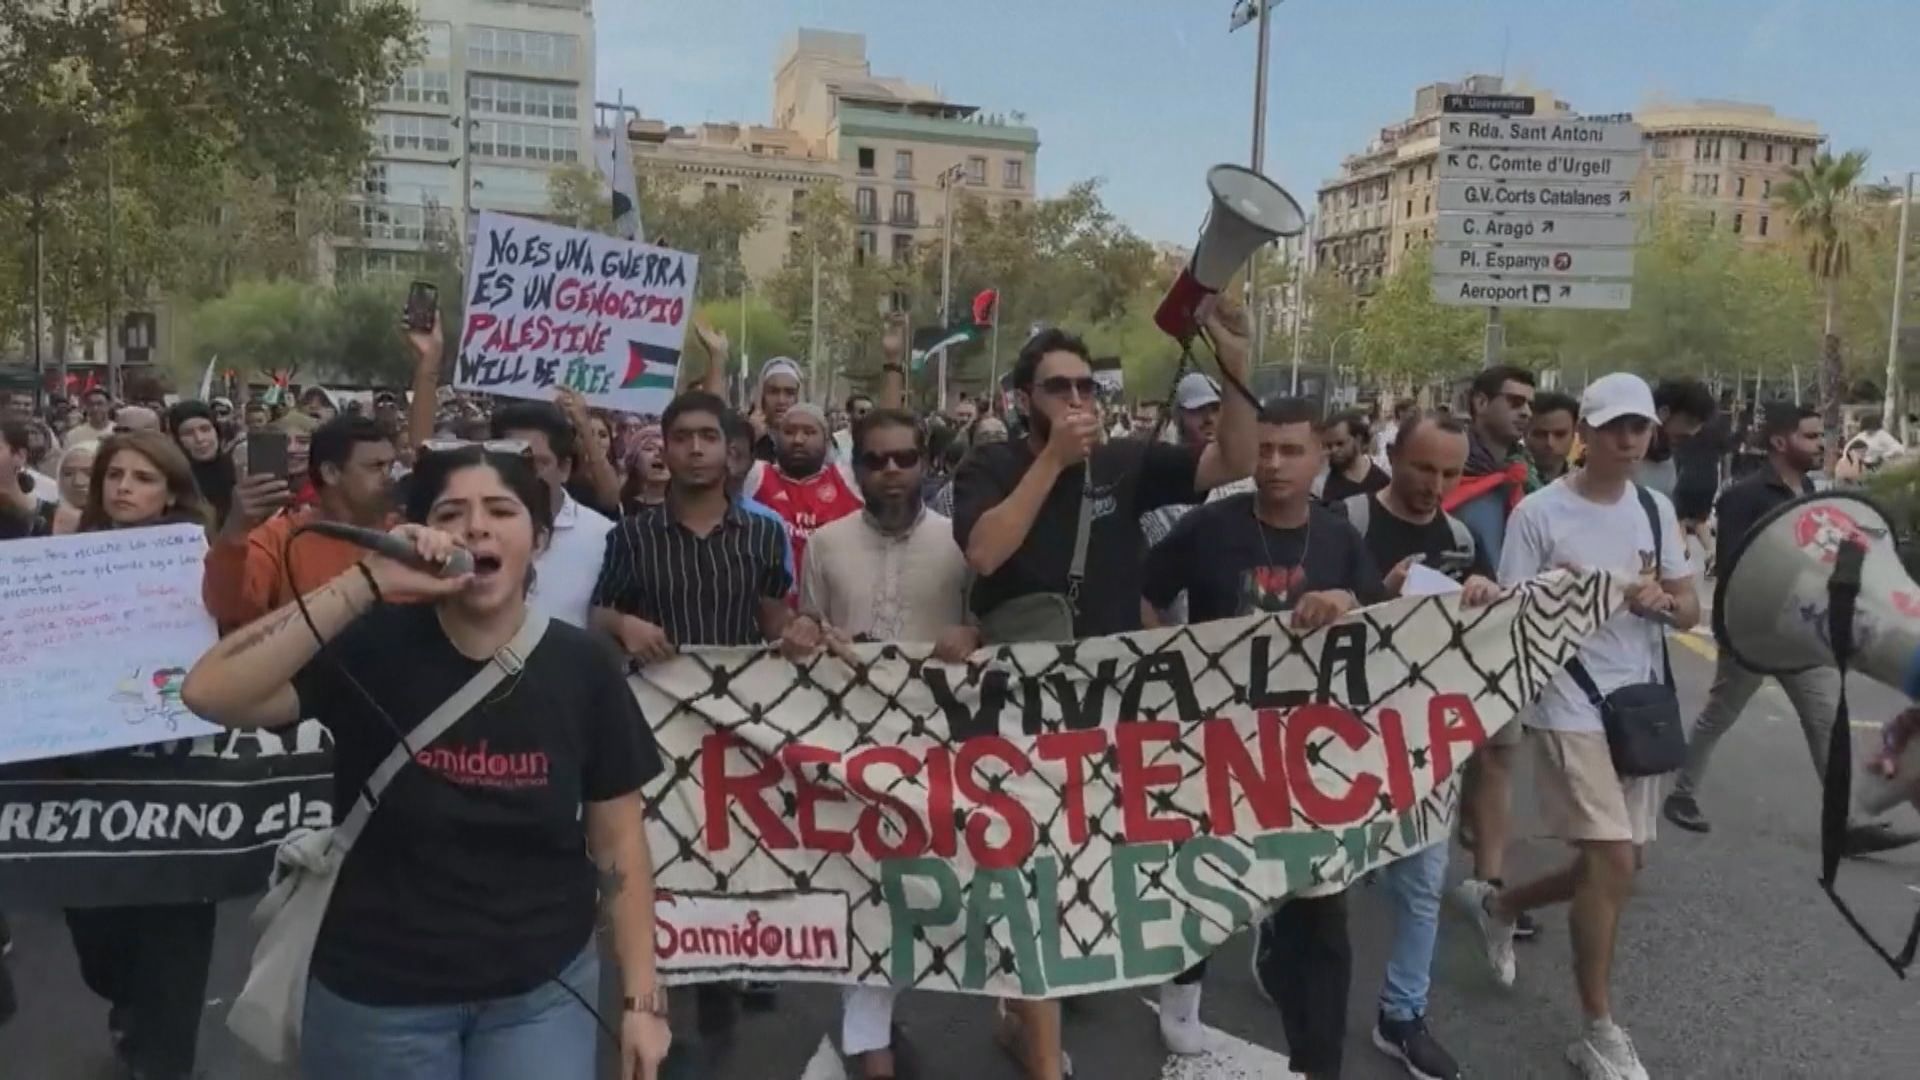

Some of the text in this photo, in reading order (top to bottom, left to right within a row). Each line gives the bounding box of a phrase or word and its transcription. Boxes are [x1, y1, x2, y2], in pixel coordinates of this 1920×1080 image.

[1469, 122, 1603, 141] Rda. Sant Antoni
[1467, 154, 1611, 176] C. Comte d'Urgell
[1540, 189, 1611, 206] Catalanes
[1463, 218, 1480, 234] C.
[556, 238, 594, 275] UNA
[602, 249, 687, 288] GUERRA
[1460, 251, 1549, 270] Pl. Espanya
[471, 270, 515, 309] ES
[524, 273, 556, 310] UN
[1460, 282, 1528, 301] Aeroport
[463, 314, 611, 356] PALESTINE
[460, 351, 615, 394] WILL BE FREE
[923, 623, 1369, 741] VIVA LA
[416, 740, 549, 775] amidoun
[702, 692, 1488, 869] RESISTENCIA
[0, 798, 244, 842] RETORNO
[655, 889, 837, 960] Samidoun
